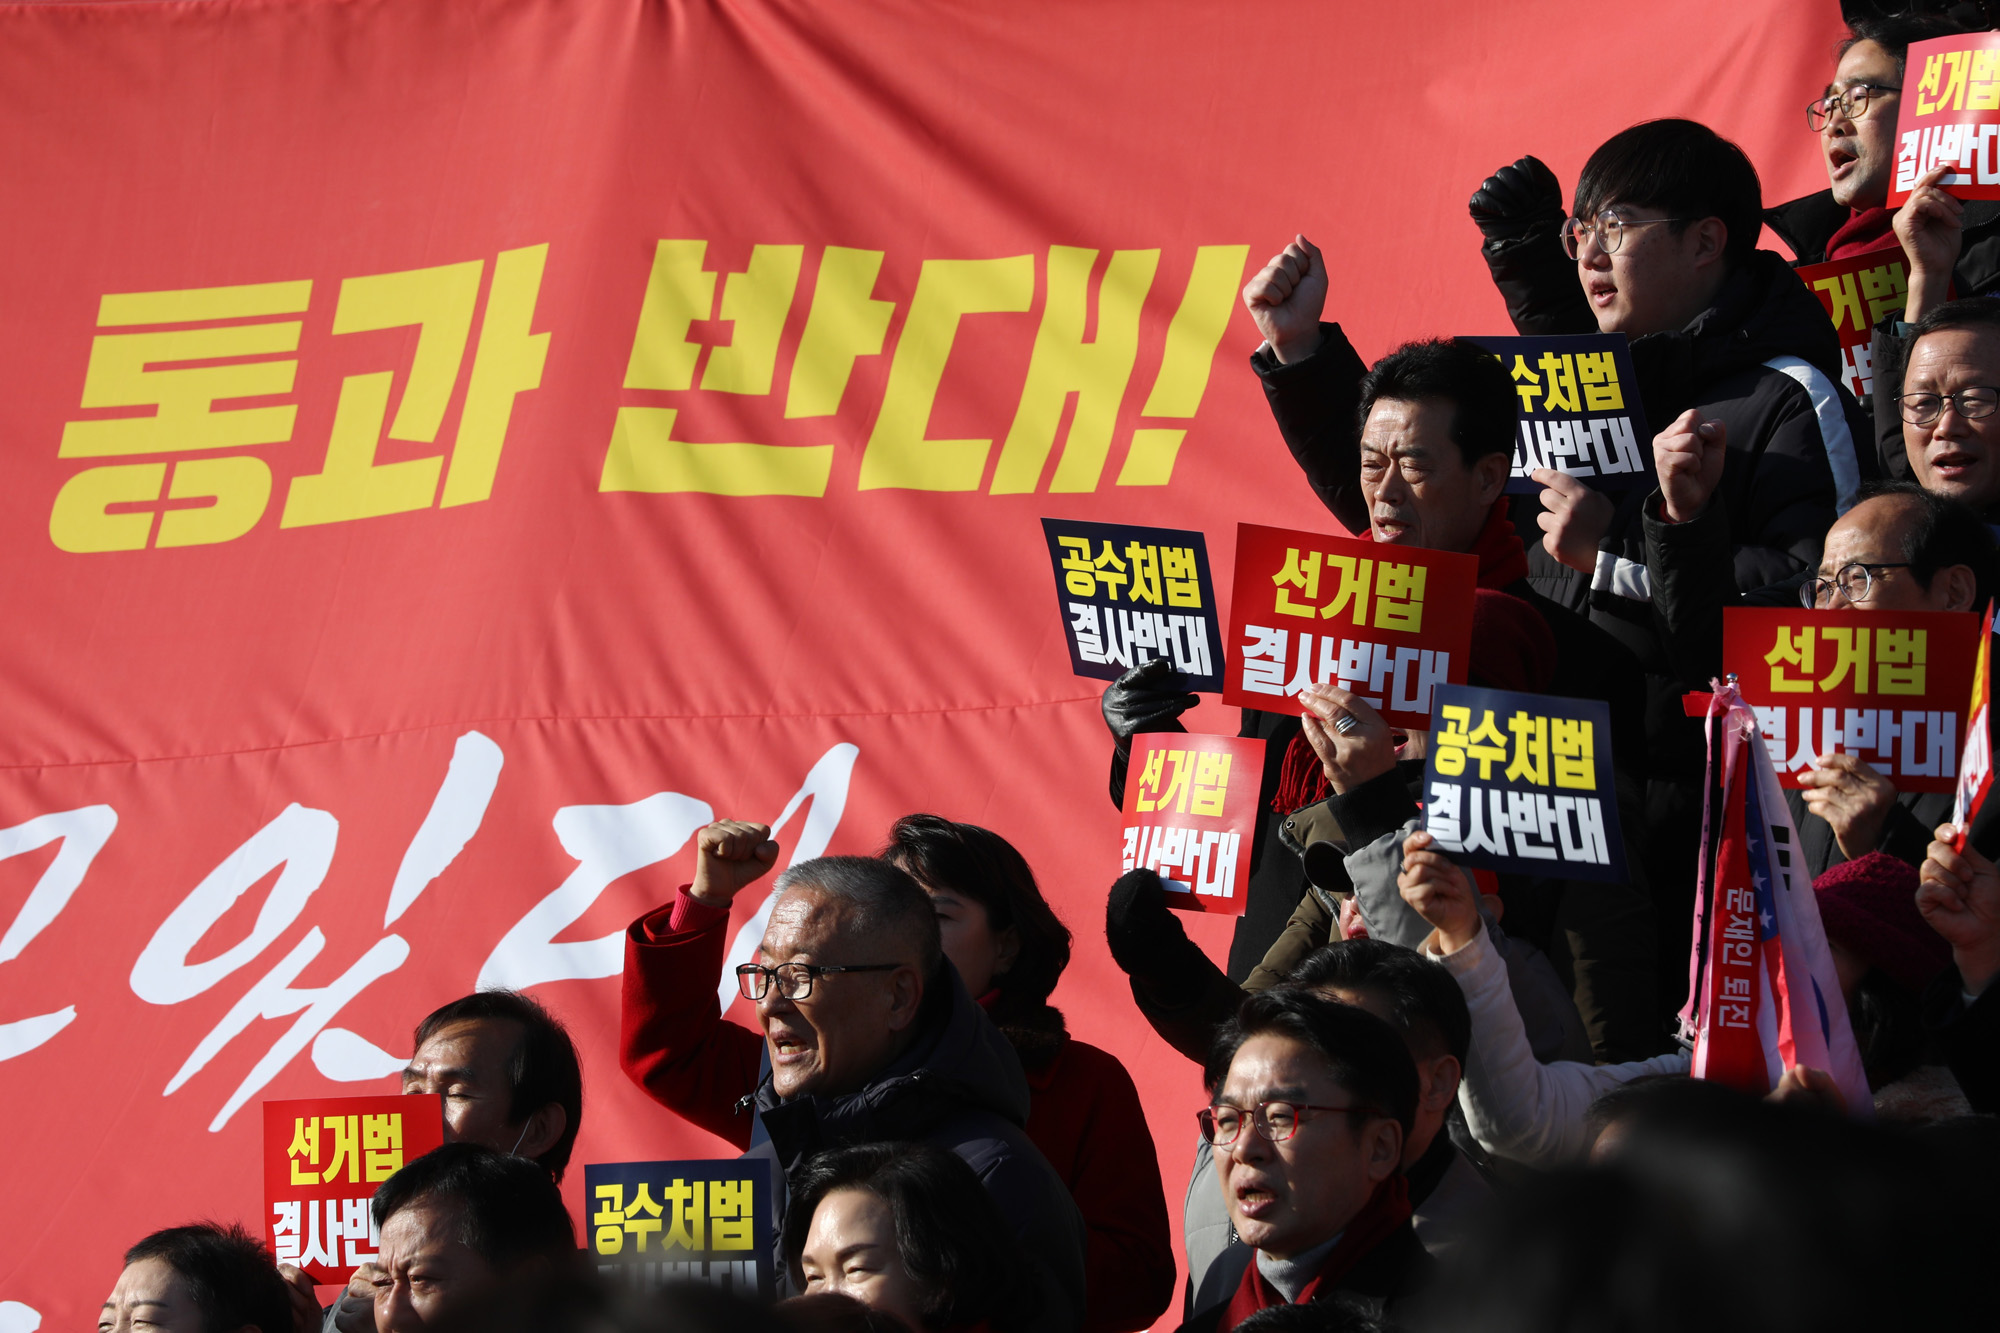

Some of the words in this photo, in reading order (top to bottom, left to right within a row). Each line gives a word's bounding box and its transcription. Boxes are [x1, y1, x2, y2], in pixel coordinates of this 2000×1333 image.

[1803, 261, 1908, 332] 거법
[50, 243, 551, 553] 통과
[599, 239, 1249, 497] 반대!
[1494, 351, 1625, 413] 수처법
[1509, 416, 1645, 478] 사반대
[1057, 535, 1202, 609] 공수처법
[1271, 547, 1428, 634] 선거법
[1068, 602, 1213, 676] 결사반대
[1241, 624, 1450, 715] 결사반대
[1763, 625, 1928, 696] 선거법
[1135, 749, 1233, 818] 선거법
[1434, 704, 1597, 791] 공수처법
[1426, 781, 1611, 865] 결사반대
[1722, 887, 1755, 967] 문재인
[1718, 975, 1751, 1030] 퇴진
[286, 1112, 404, 1186] 선거법
[593, 1178, 754, 1256] 공수처법
